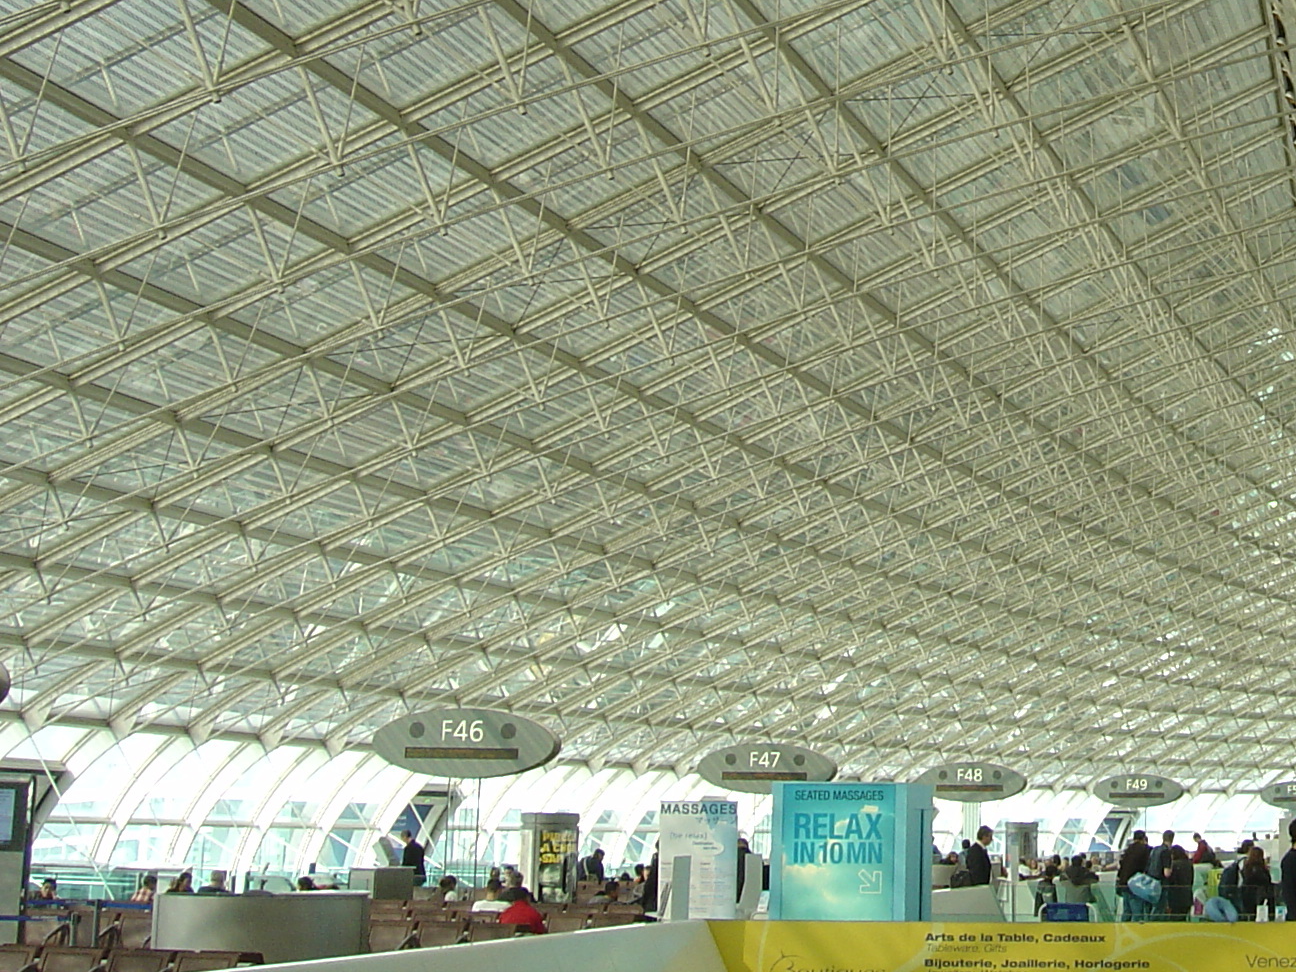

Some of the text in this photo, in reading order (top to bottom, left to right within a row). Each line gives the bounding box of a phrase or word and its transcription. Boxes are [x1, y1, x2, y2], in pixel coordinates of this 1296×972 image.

[441, 719, 484, 743] F46
[749, 751, 781, 768] F47
[956, 768, 983, 782] F48
[1126, 778, 1148, 791] F49
[794, 790, 884, 801] SEATED MASSAGES
[660, 803, 737, 815] MASSAGES
[794, 813, 883, 840] RELAX
[793, 841, 883, 864] IN 10 MN
[925, 932, 1106, 944] Arts de la Table, Cadeaux
[924, 959, 1150, 970] Bijouterie, Joaillerie, Horlogerie
